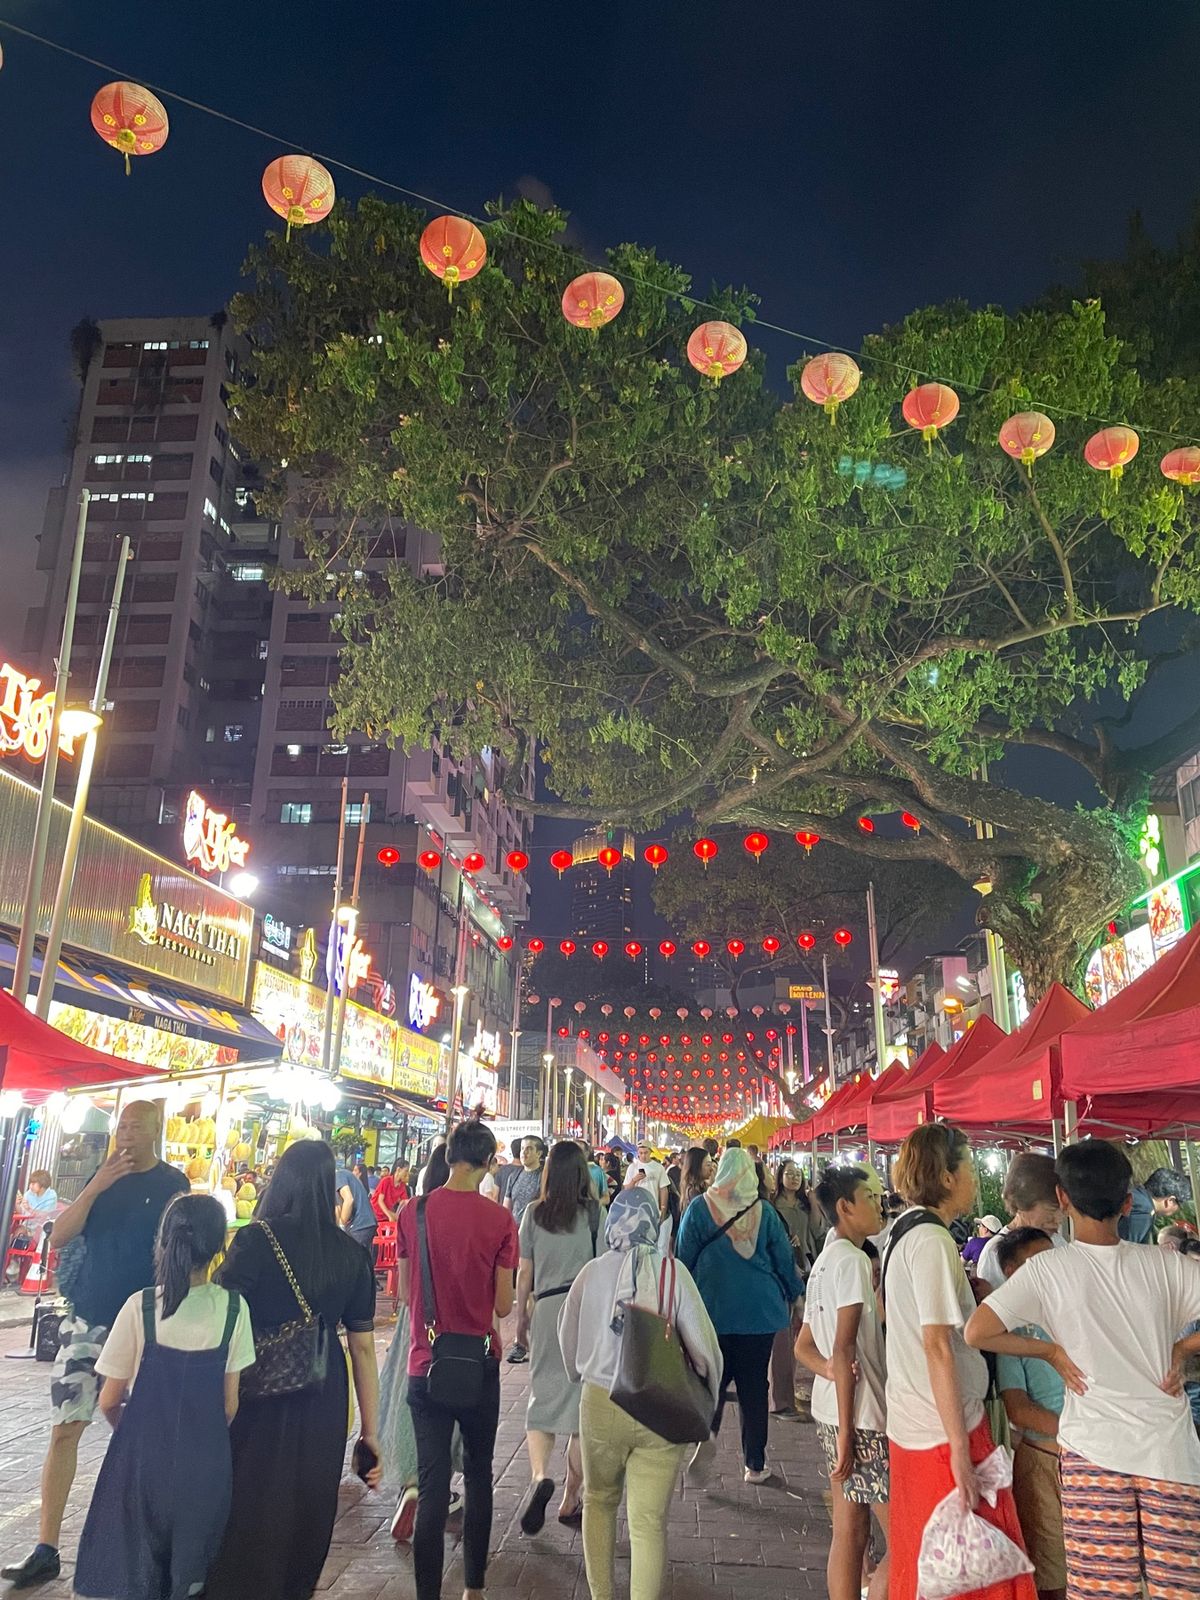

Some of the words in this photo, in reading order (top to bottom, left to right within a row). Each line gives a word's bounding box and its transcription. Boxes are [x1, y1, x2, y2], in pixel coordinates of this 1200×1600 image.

[205, 808, 249, 872] Tiger
[159, 935, 217, 966] RESTAURANT
[161, 902, 203, 945] NAGA
[208, 924, 240, 961] THAI
[154, 1015, 172, 1032] NAGA
[173, 1020, 187, 1035] THAI
